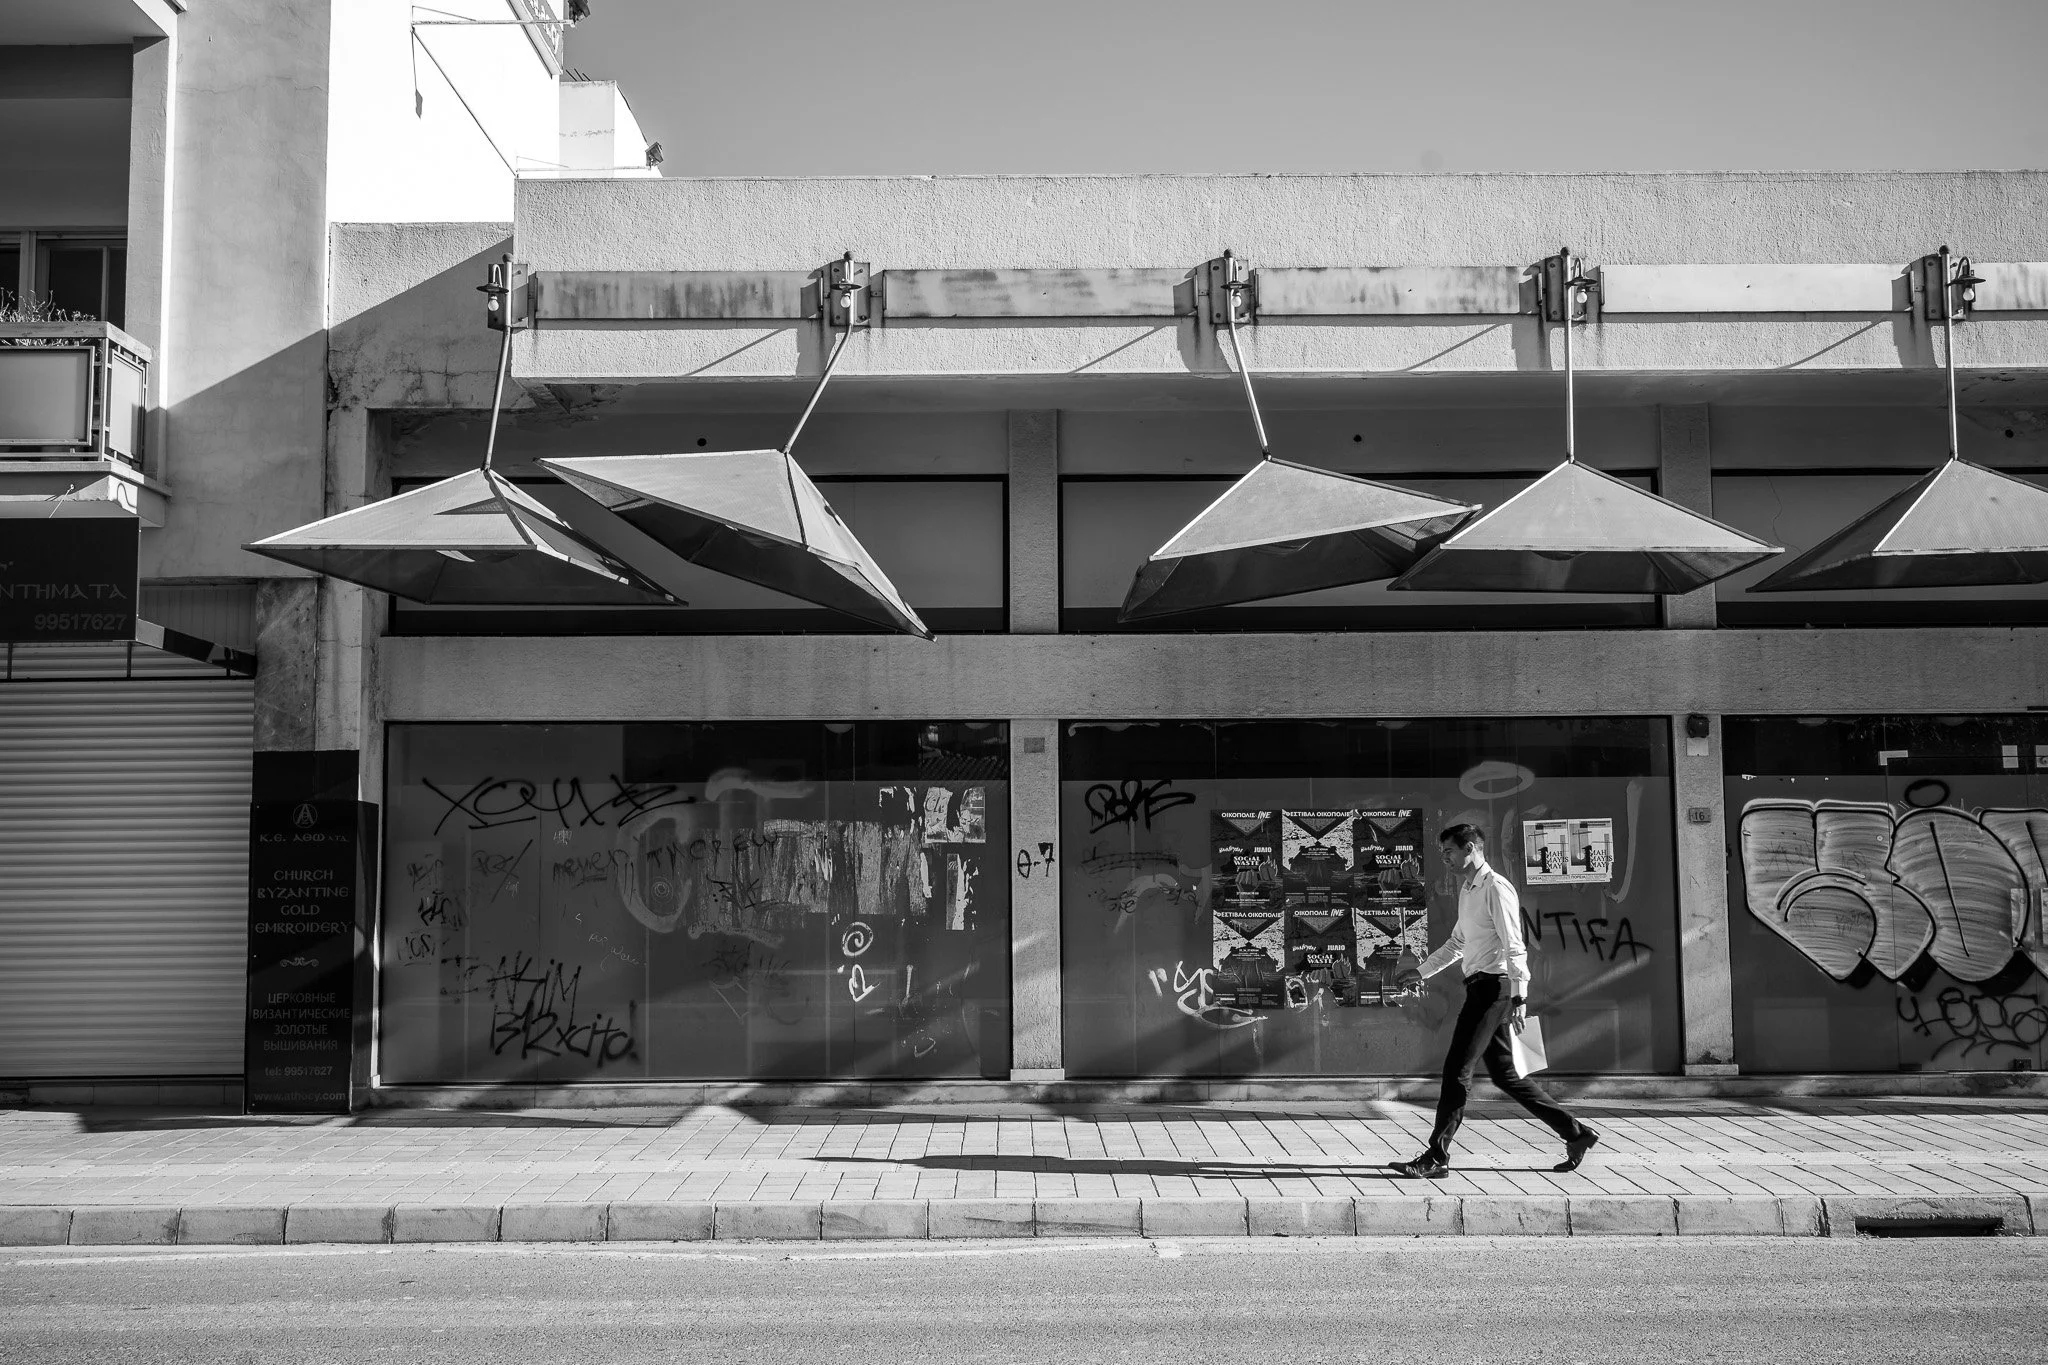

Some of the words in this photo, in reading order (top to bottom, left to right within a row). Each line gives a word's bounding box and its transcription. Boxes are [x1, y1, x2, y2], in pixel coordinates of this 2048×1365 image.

[34, 613, 128, 631] 99517627
[1694, 811, 1705, 820] 16
[273, 869, 334, 881] CHURCH
[257, 886, 349, 899] BYZANTINE
[280, 904, 320, 916] GOLD
[254, 921, 351, 934] EMBROIDERY
[1520, 906, 1653, 963] NTIFA
[268, 992, 336, 1004] ЦЕРКОВНЫЕ
[252, 1008, 351, 1020] ВИЗАНТИЧЕСКИЕ
[274, 1024, 328, 1035] ЗОЛОТЫЕ
[263, 1040, 339, 1051] ВЫШИВАНИЯ
[264, 1066, 282, 1076] tel:
[284, 1066, 333, 1076] 99517627
